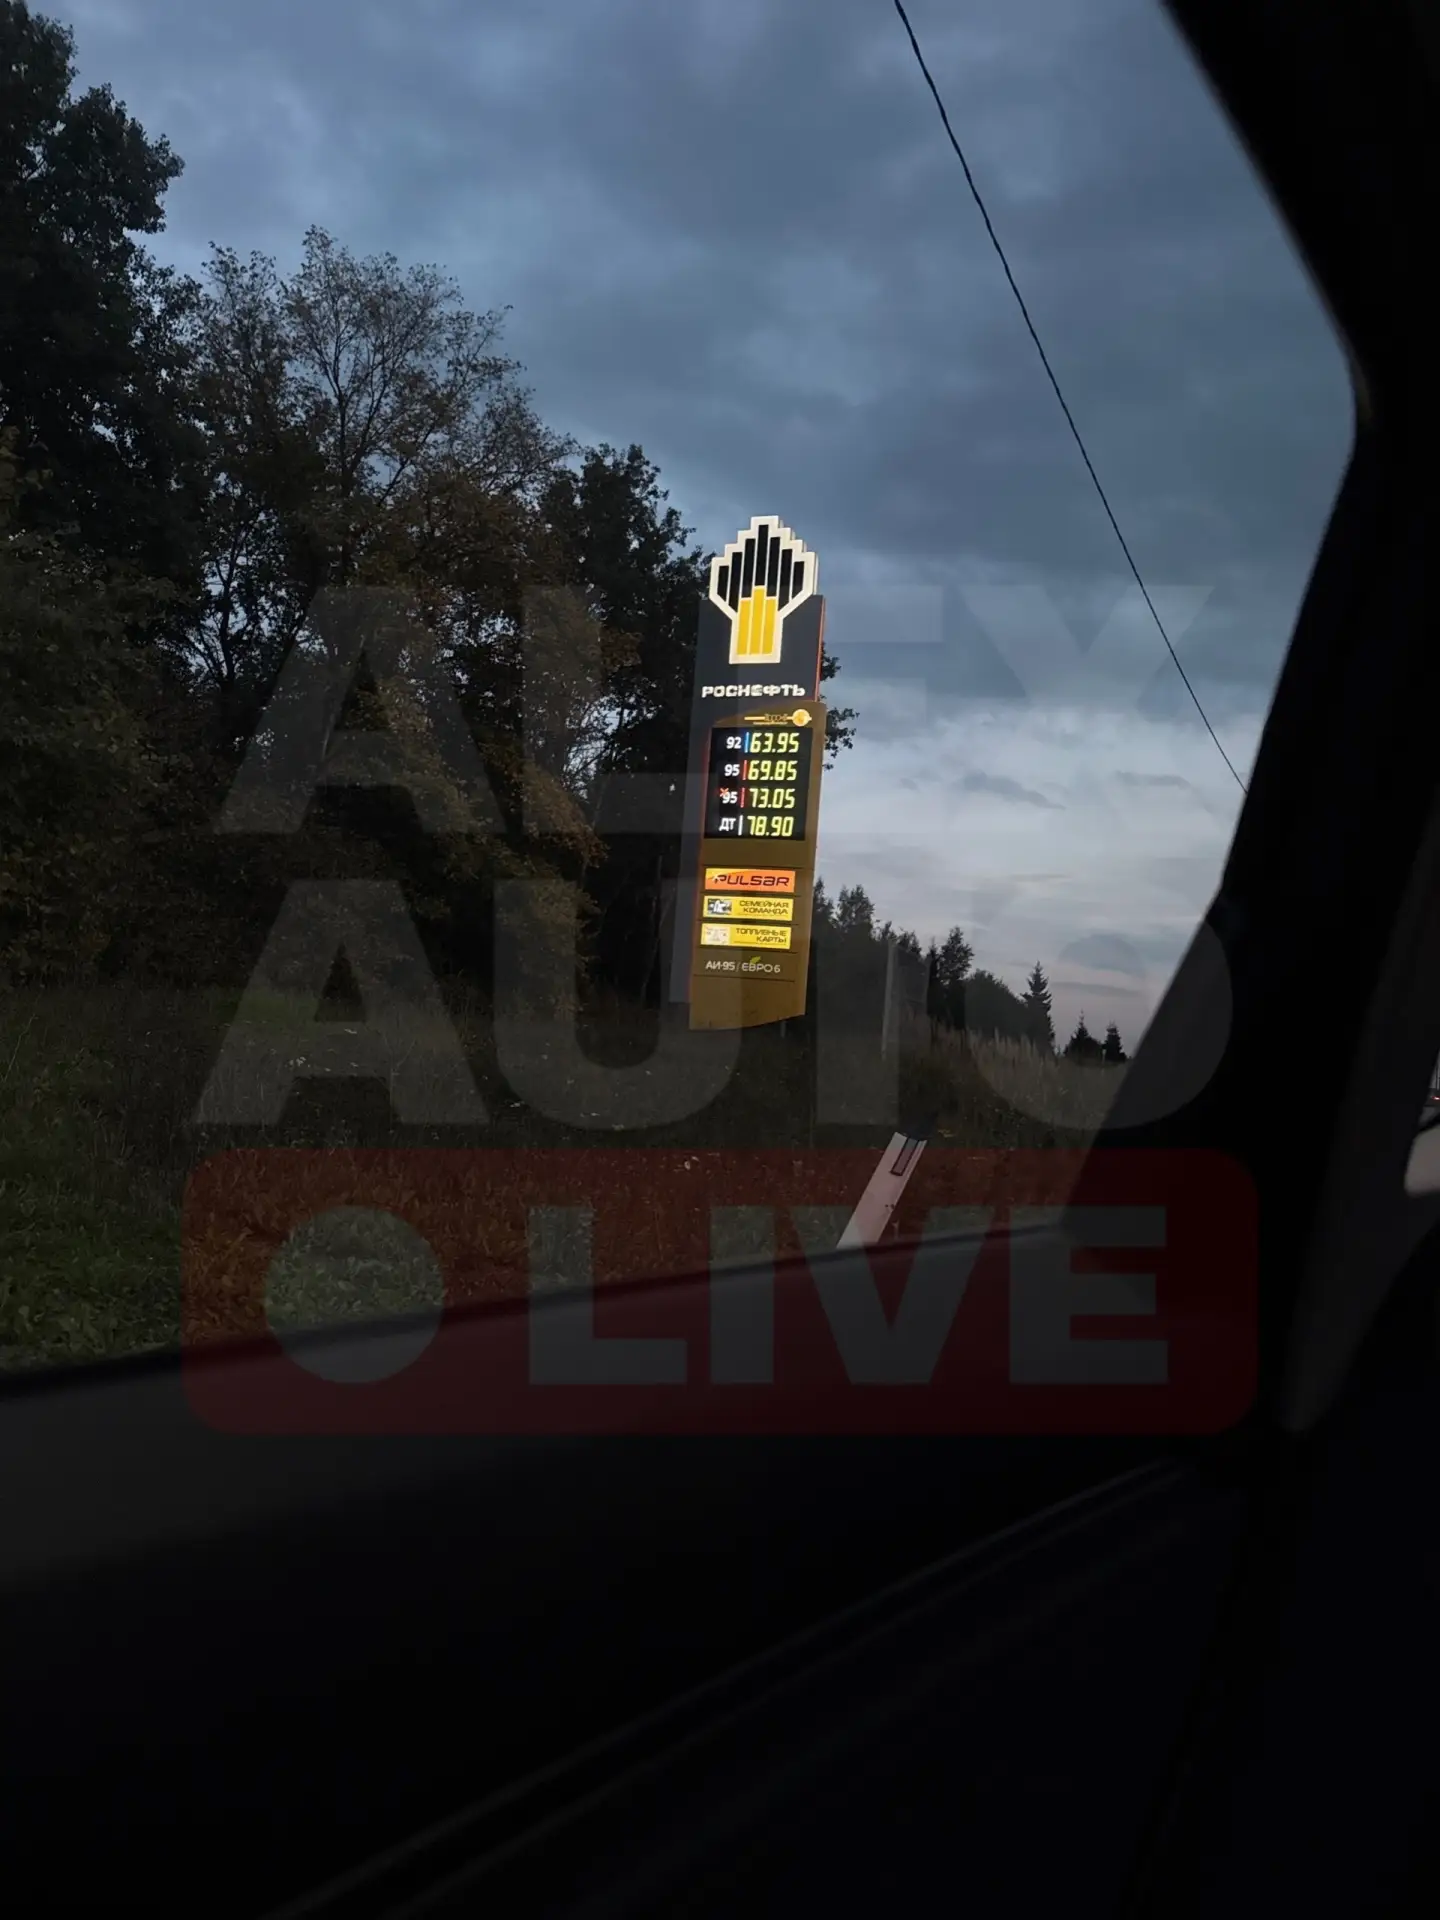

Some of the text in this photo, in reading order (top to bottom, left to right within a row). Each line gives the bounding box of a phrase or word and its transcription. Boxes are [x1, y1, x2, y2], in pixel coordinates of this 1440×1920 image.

[702, 684, 805, 698] РОСНЕФТЬ
[726, 733, 800, 753] 92 63.95
[724, 760, 798, 780] 95 69.85
[722, 788, 796, 808] 95 73.05
[718, 816, 794, 836] ДТ 78.90
[739, 900, 789, 908] СЕМЕЙНАЯ
[743, 906, 788, 915] КОМАНДА
[736, 927, 787, 936] ТОПЛИВНЫЕ
[705, 961, 735, 971] АИ-95
